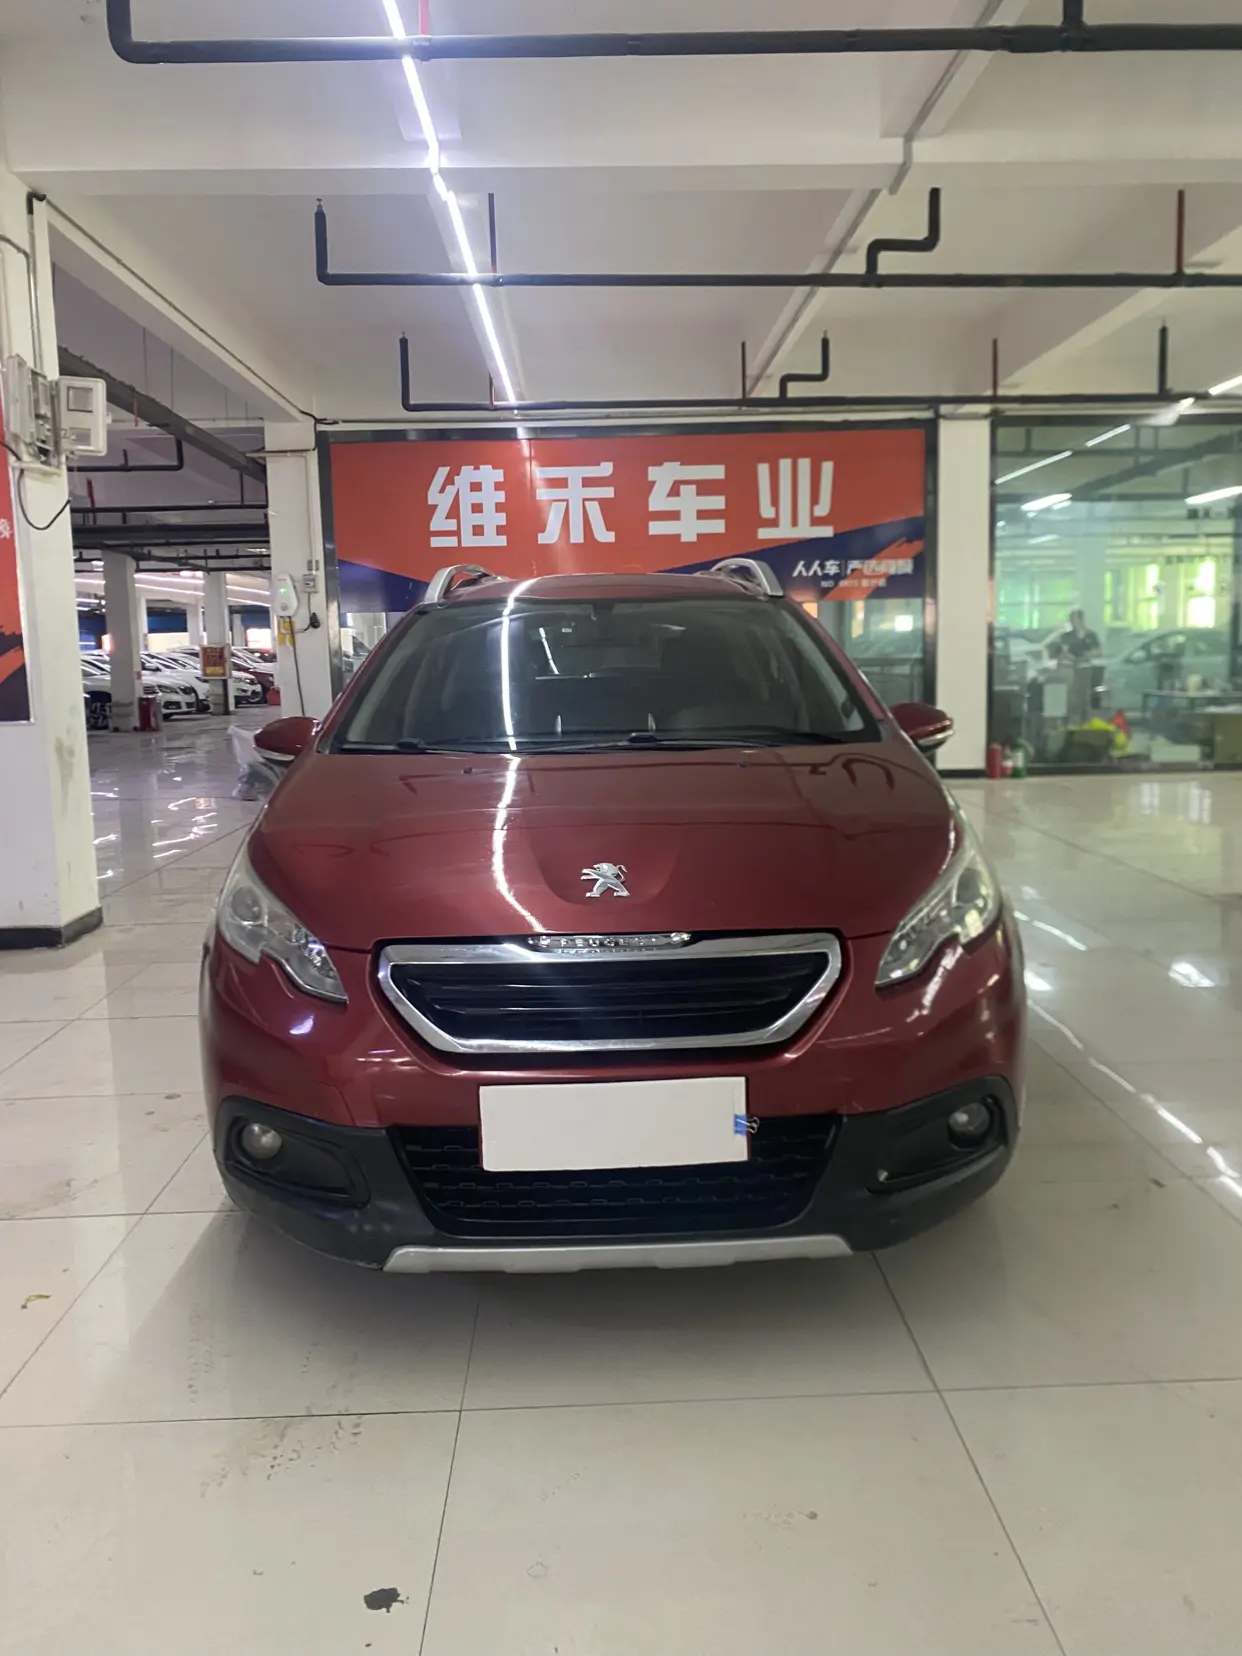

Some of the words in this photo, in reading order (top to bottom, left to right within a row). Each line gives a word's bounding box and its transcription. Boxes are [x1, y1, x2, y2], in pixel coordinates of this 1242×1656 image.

[427, 457, 834, 548] 维禾车业
[792, 559, 841, 577] 人人车
